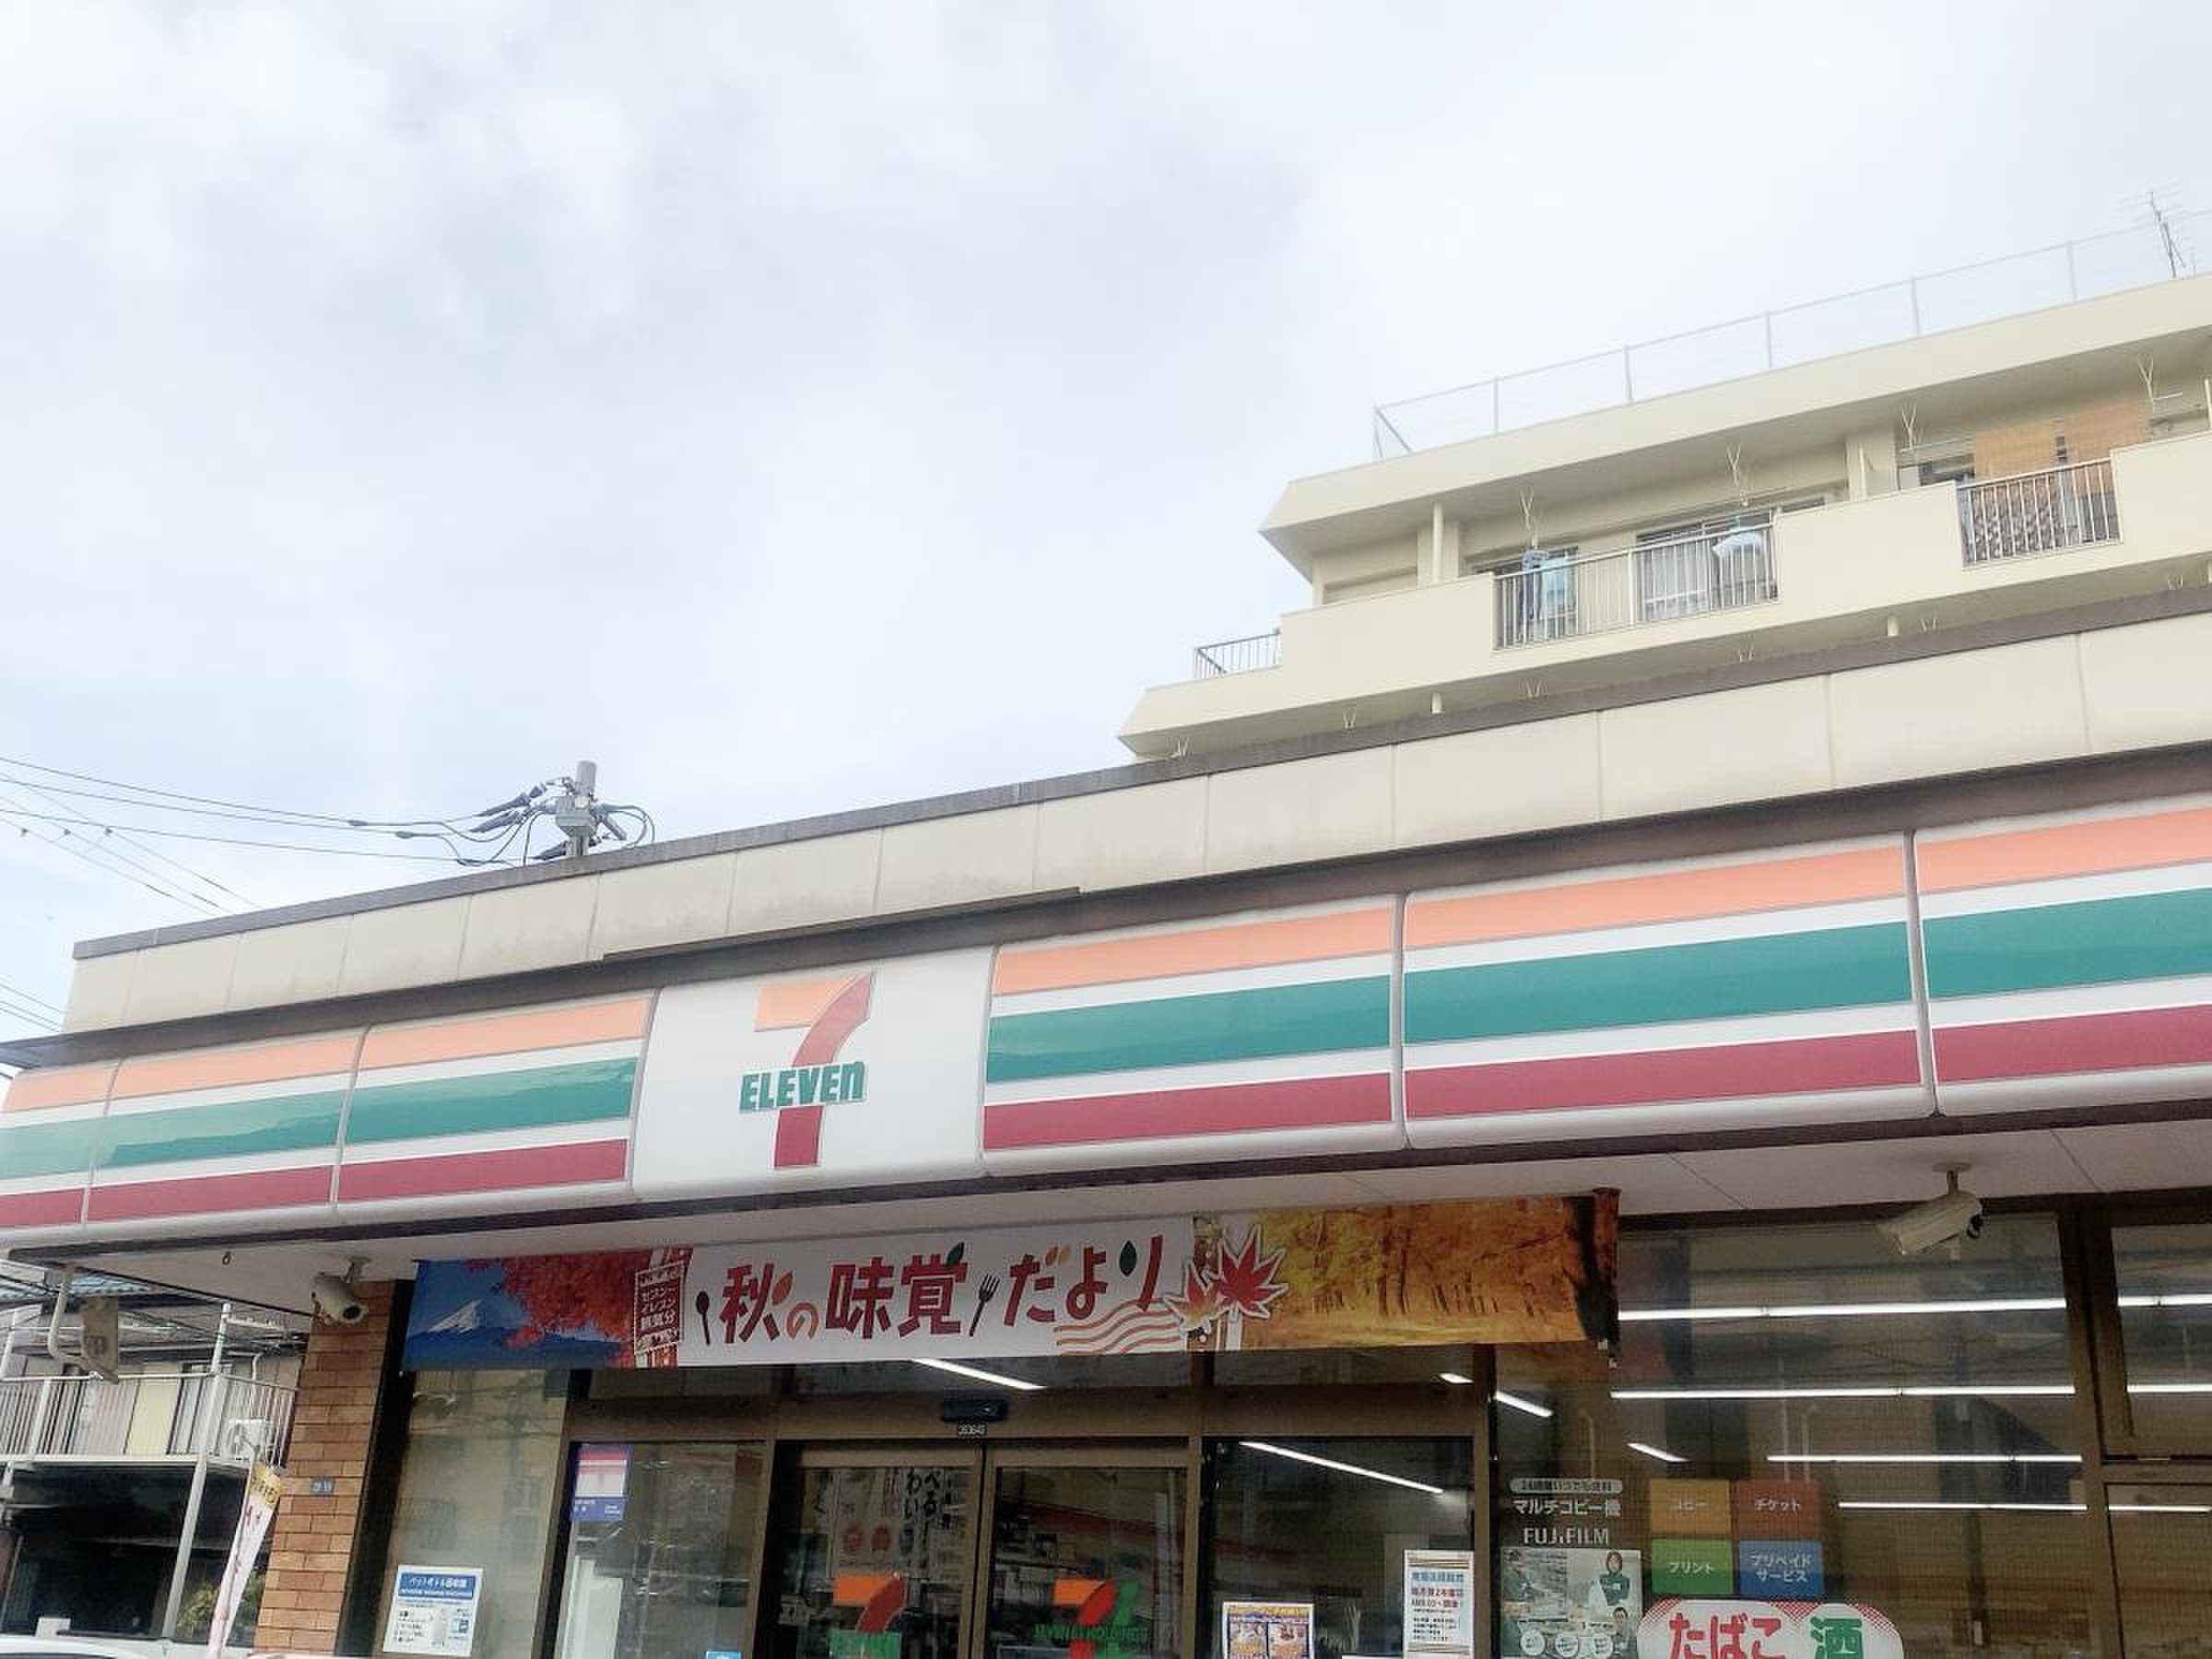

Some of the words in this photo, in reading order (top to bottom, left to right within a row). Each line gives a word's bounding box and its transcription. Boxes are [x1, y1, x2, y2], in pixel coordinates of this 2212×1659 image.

[1512, 1498, 1623, 1518] マルチコピー機
[1670, 1497, 1709, 1512] コピー
[1753, 1497, 1800, 1512] チケット
[1669, 1559, 1714, 1575] プリント
[1750, 1553, 1812, 1568] プリペイド
[1755, 1569, 1808, 1583] サービス
[1668, 1613, 1786, 1659] たばこ
[1809, 1616, 1864, 1659] 酒
